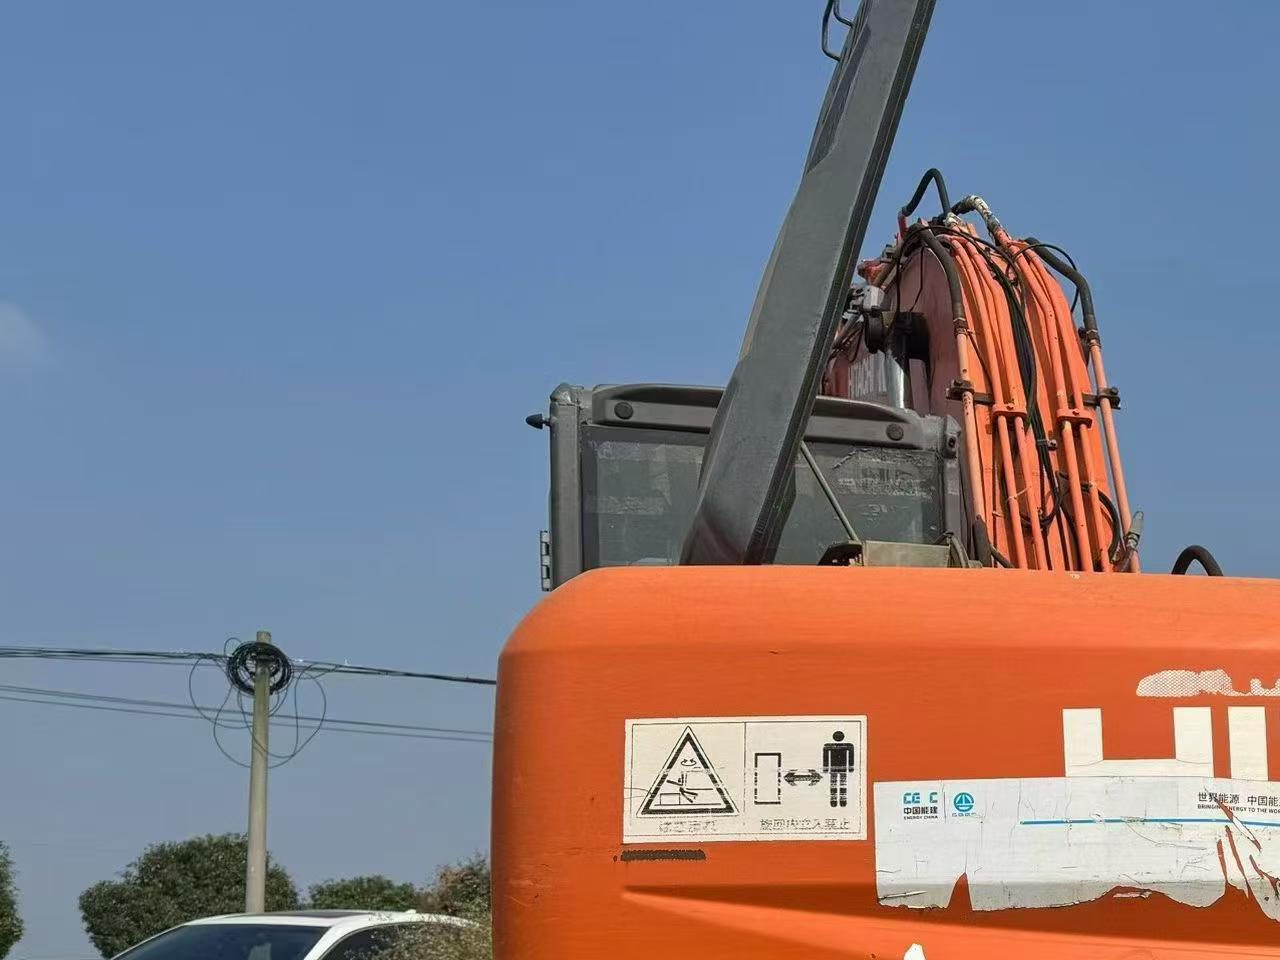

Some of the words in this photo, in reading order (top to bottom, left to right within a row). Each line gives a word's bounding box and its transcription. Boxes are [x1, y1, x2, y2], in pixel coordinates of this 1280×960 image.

[1198, 791, 1240, 804] 世界能源
[903, 806, 938, 815] 中国能建
